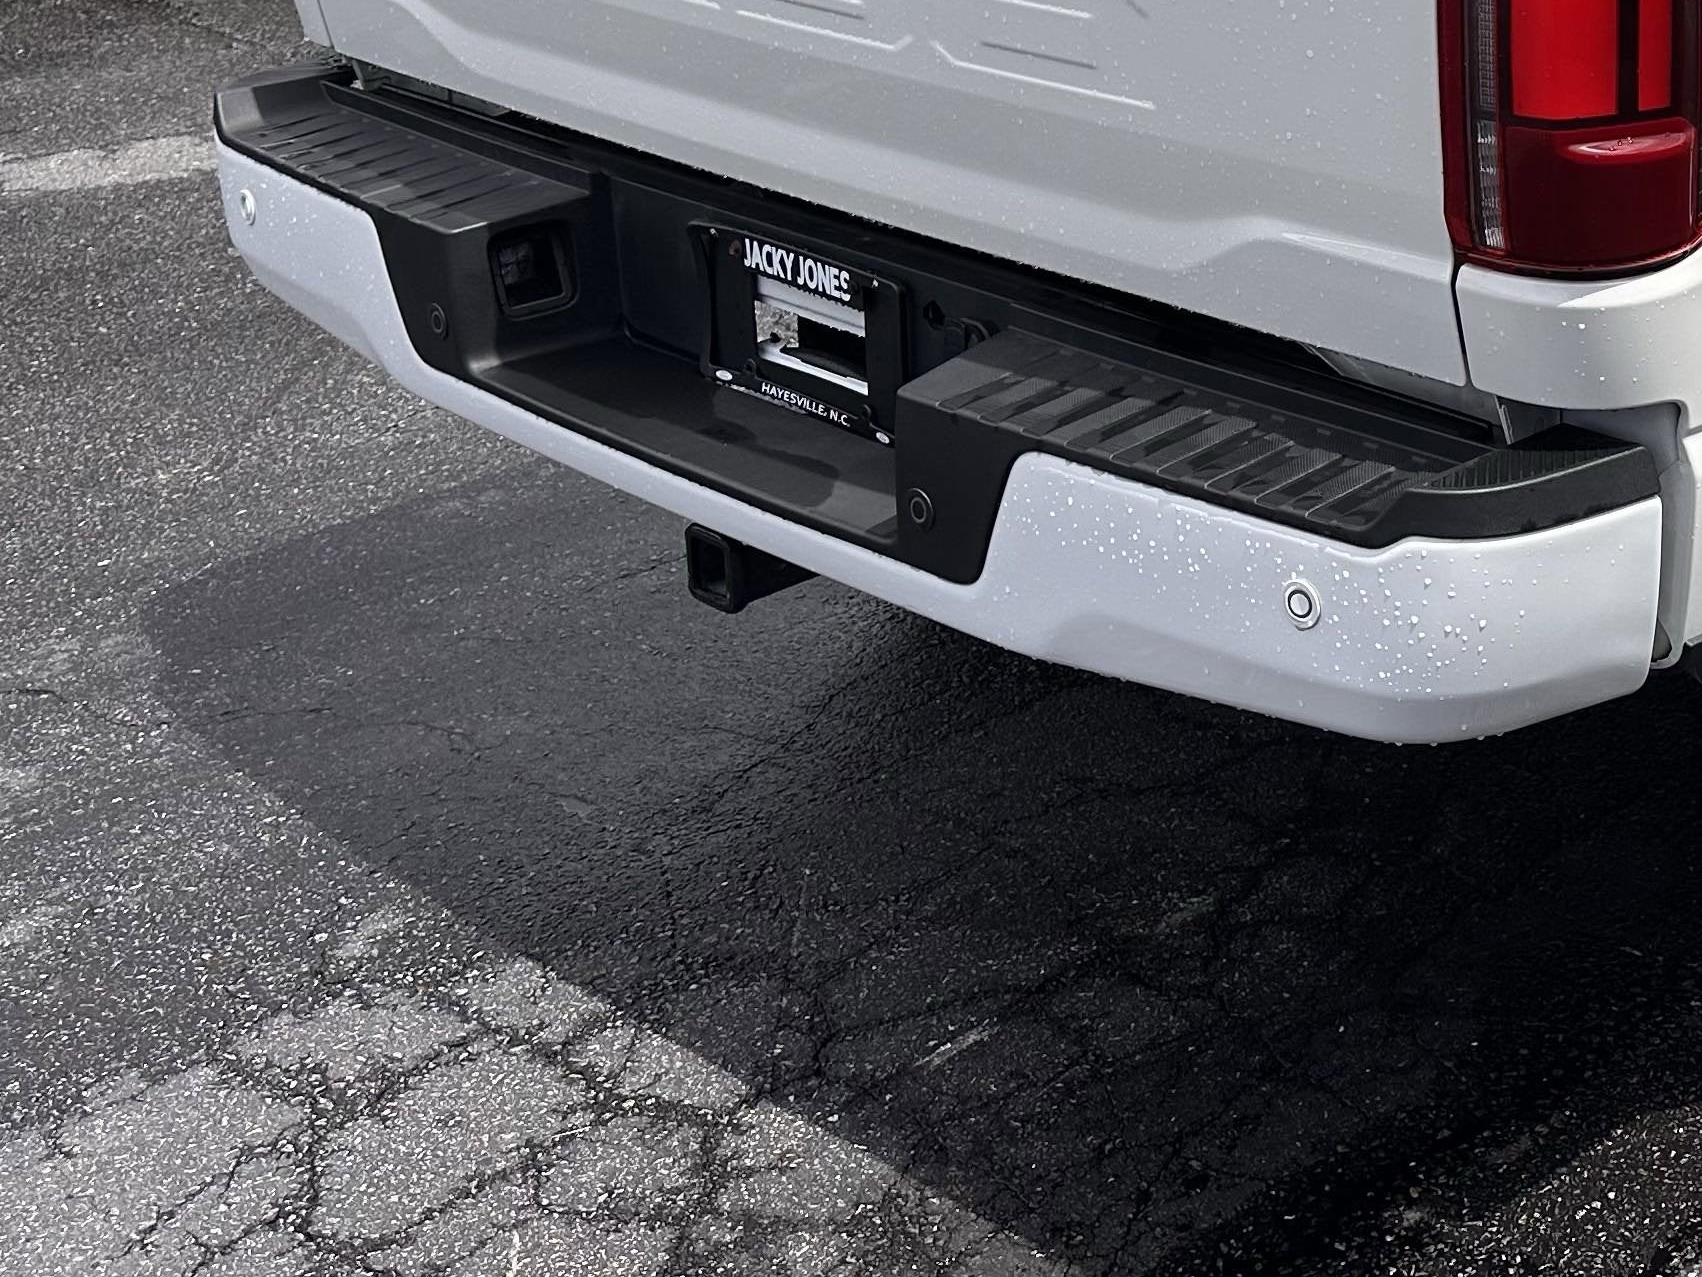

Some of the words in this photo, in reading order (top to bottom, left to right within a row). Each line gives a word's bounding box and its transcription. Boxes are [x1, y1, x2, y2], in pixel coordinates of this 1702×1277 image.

[742, 237, 798, 282] JACKY
[796, 256, 852, 303] JONES
[761, 382, 828, 418] HAYESVILLE,
